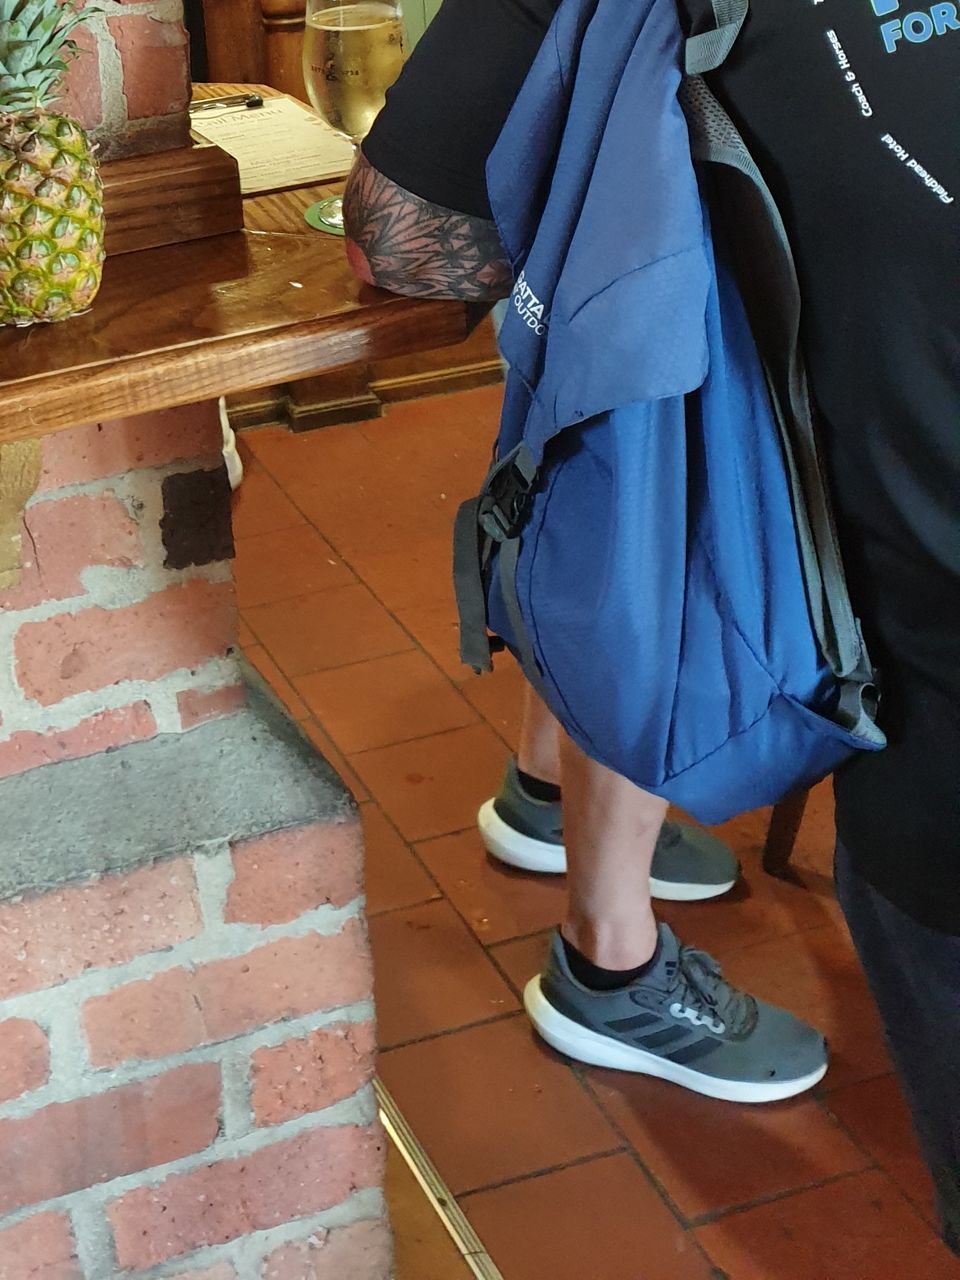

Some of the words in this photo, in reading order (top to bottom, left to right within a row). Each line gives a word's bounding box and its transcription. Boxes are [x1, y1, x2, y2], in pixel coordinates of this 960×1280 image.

[826, 28, 851, 70] Horses
[851, 82, 874, 118] Coach
[880, 132, 909, 162] Hotel
[906, 158, 955, 205] Fieldhead
[514, 294, 546, 336] OUTDO
